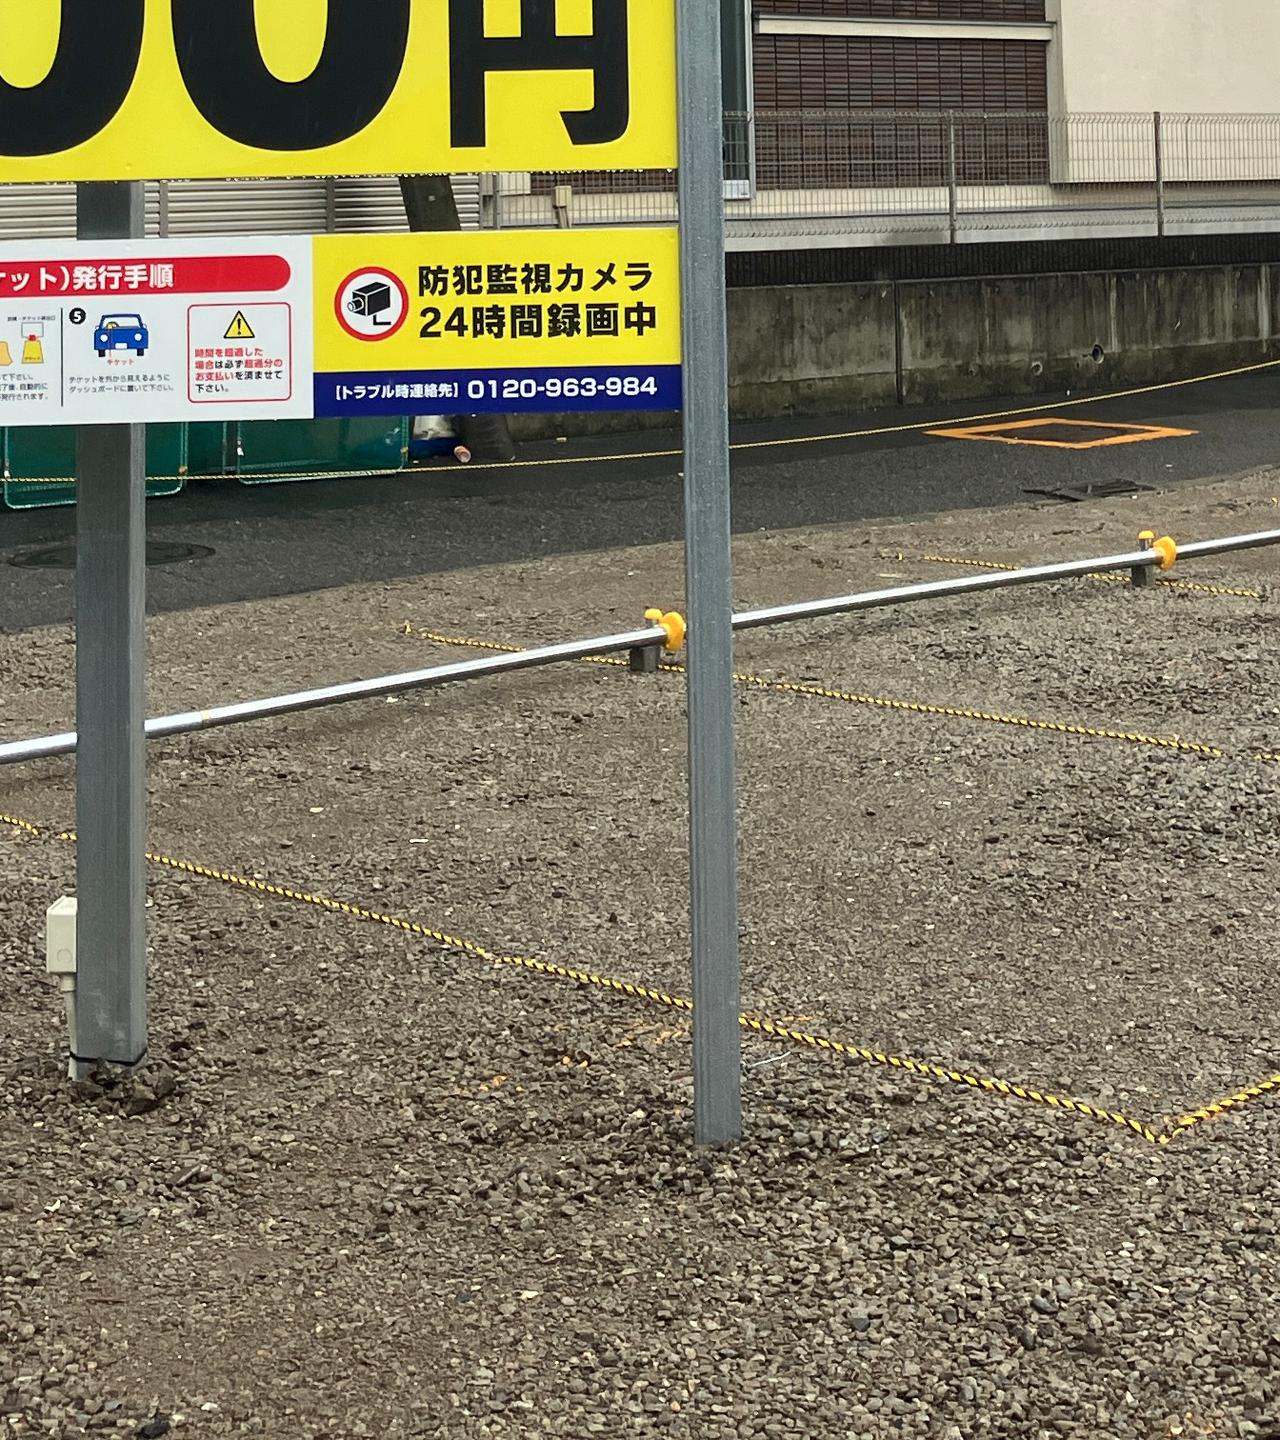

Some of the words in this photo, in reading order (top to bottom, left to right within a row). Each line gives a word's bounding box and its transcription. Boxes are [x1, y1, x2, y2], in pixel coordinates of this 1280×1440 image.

[418, 262, 654, 297] 防犯監視カメラ
[420, 301, 657, 338] 24時間録画中
[195, 347, 264, 358] 時間を超過した
[195, 359, 283, 369] 場合は必ず超過分の
[195, 370, 283, 381] お支払いを済ませて
[195, 383, 229, 393] 下さい。
[468, 376, 658, 400] 0120-963-984
